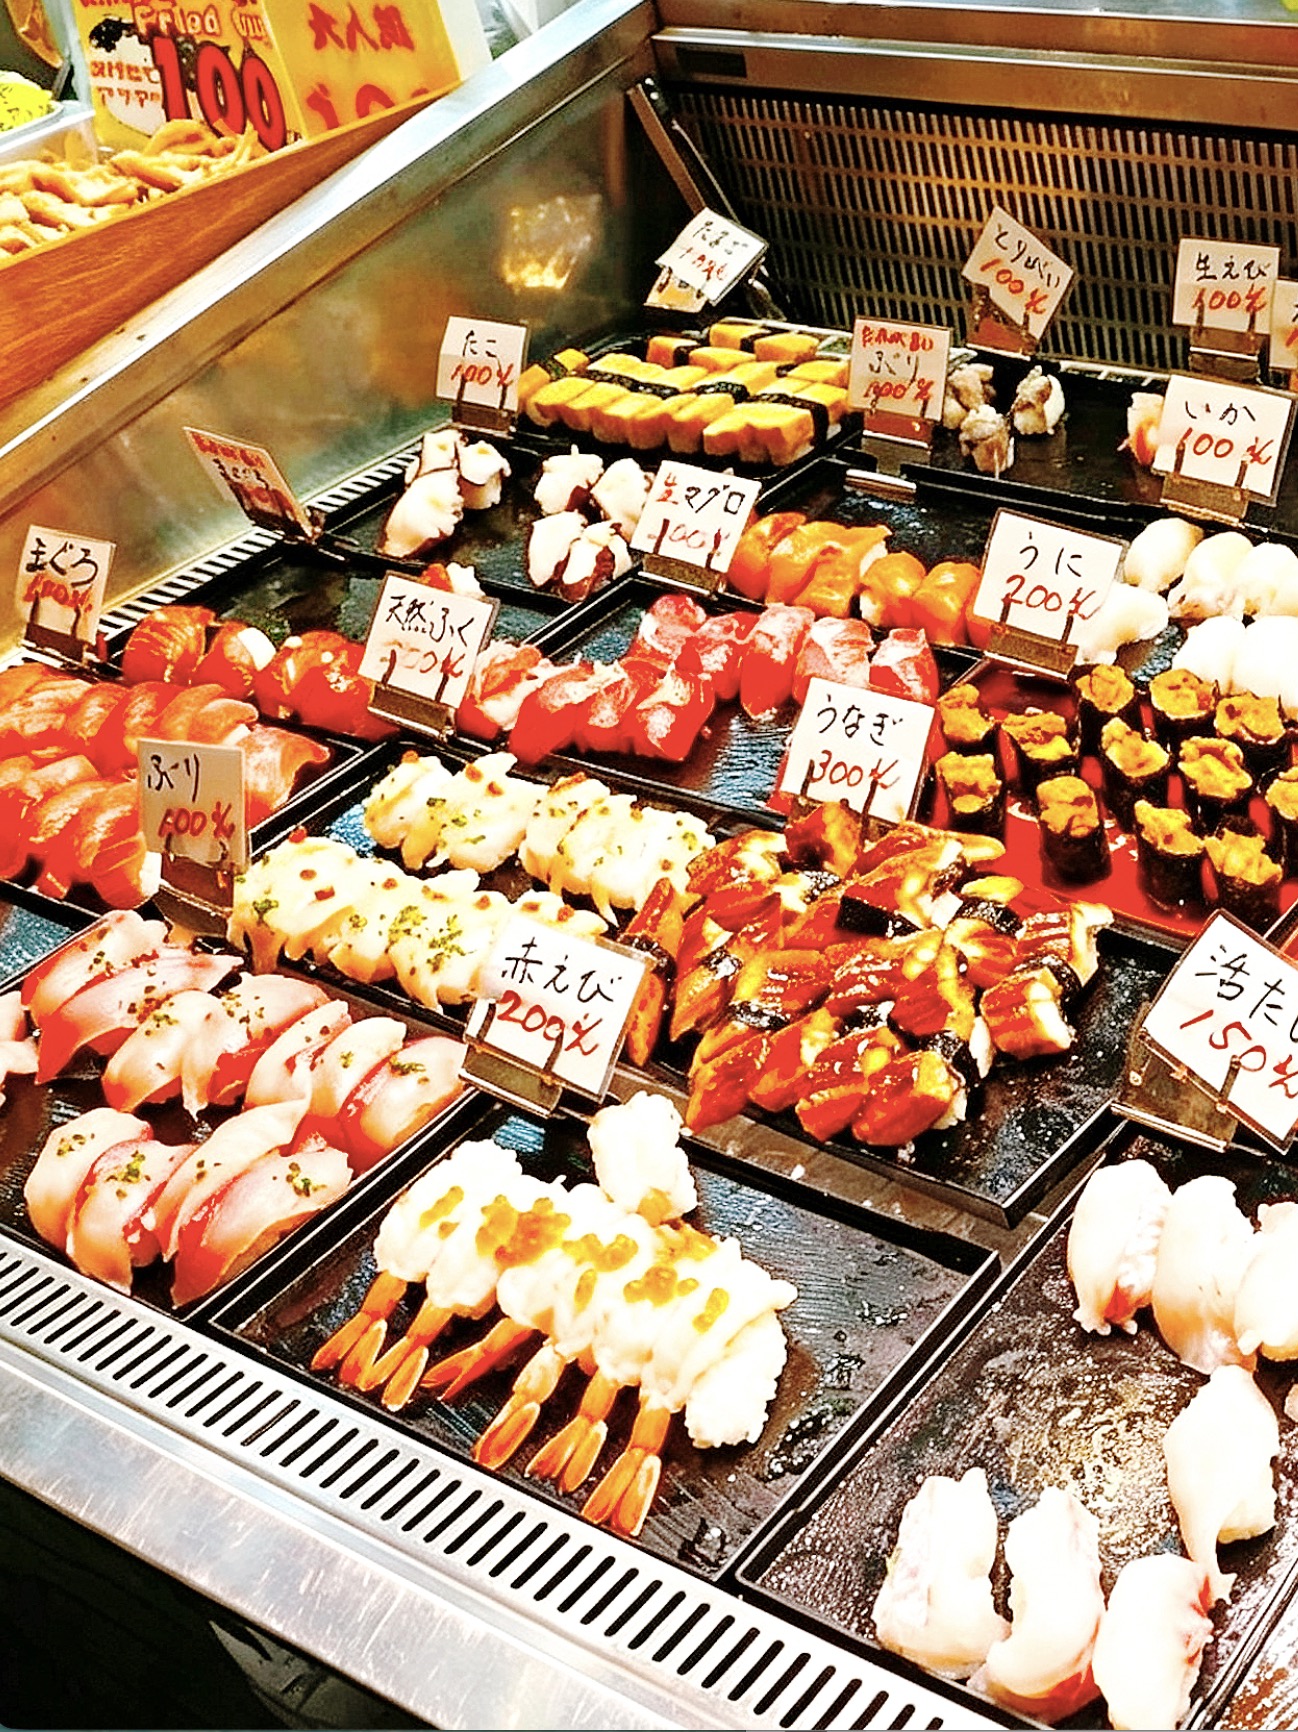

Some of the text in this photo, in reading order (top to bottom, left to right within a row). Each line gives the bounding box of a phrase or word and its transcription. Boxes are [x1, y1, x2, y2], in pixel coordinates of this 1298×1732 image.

[151, 35, 287, 152] 100
[306, 83, 430, 130] 10
[1195, 251, 1270, 282] 生えび
[462, 329, 498, 359] たこ
[868, 350, 920, 387] ぶり
[1185, 400, 1257, 426] いか
[24, 536, 98, 587] まぐろ
[1019, 531, 1083, 578] うに
[816, 692, 904, 747] うなぎ
[147, 753, 200, 803] ぶり
[500, 936, 624, 1004] 赤えび
